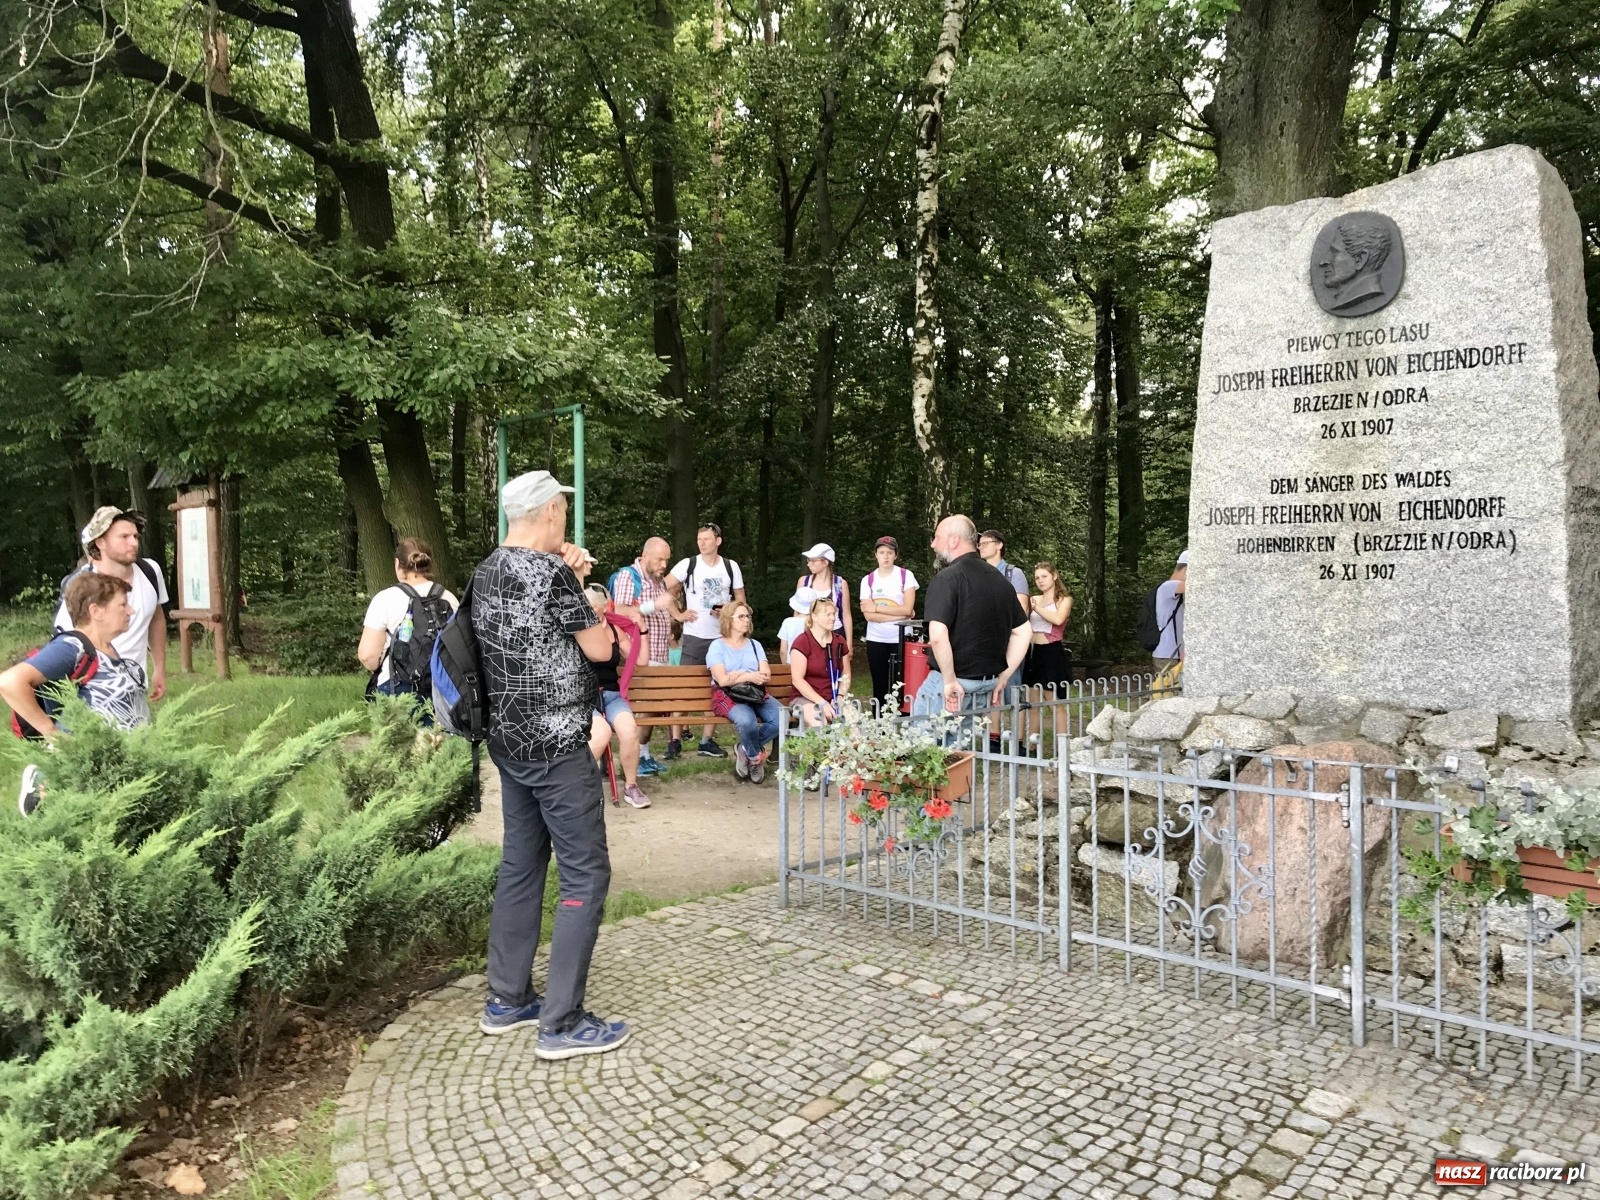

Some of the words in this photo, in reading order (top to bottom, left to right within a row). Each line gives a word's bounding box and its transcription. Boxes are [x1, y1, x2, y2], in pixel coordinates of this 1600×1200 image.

[1287, 333, 1341, 353] PIEWCY
[1346, 329, 1386, 347] TEGO
[1390, 323, 1430, 343] LASU
[1212, 370, 1265, 395] JOSEPH
[1271, 360, 1358, 388] FREIHERRN
[1365, 355, 1398, 377] VON
[1406, 343, 1527, 374] EICHENDORFF
[1321, 422, 1337, 439] 26
[1341, 421, 1356, 438] XI
[1361, 418, 1394, 436] 1907
[1270, 478, 1298, 494] DEM
[1362, 473, 1388, 490] DES
[1395, 470, 1451, 488] WALDES
[1204, 506, 1255, 526] JOSEPH
[1262, 503, 1344, 524] FREIHERRN
[1350, 502, 1381, 522] VON
[1399, 497, 1506, 521] EICHENDORFF
[1237, 536, 1336, 554] HOHENBIRKEN
[1319, 564, 1335, 580] 26
[1341, 564, 1357, 581] XI
[1366, 564, 1395, 580] 1907
